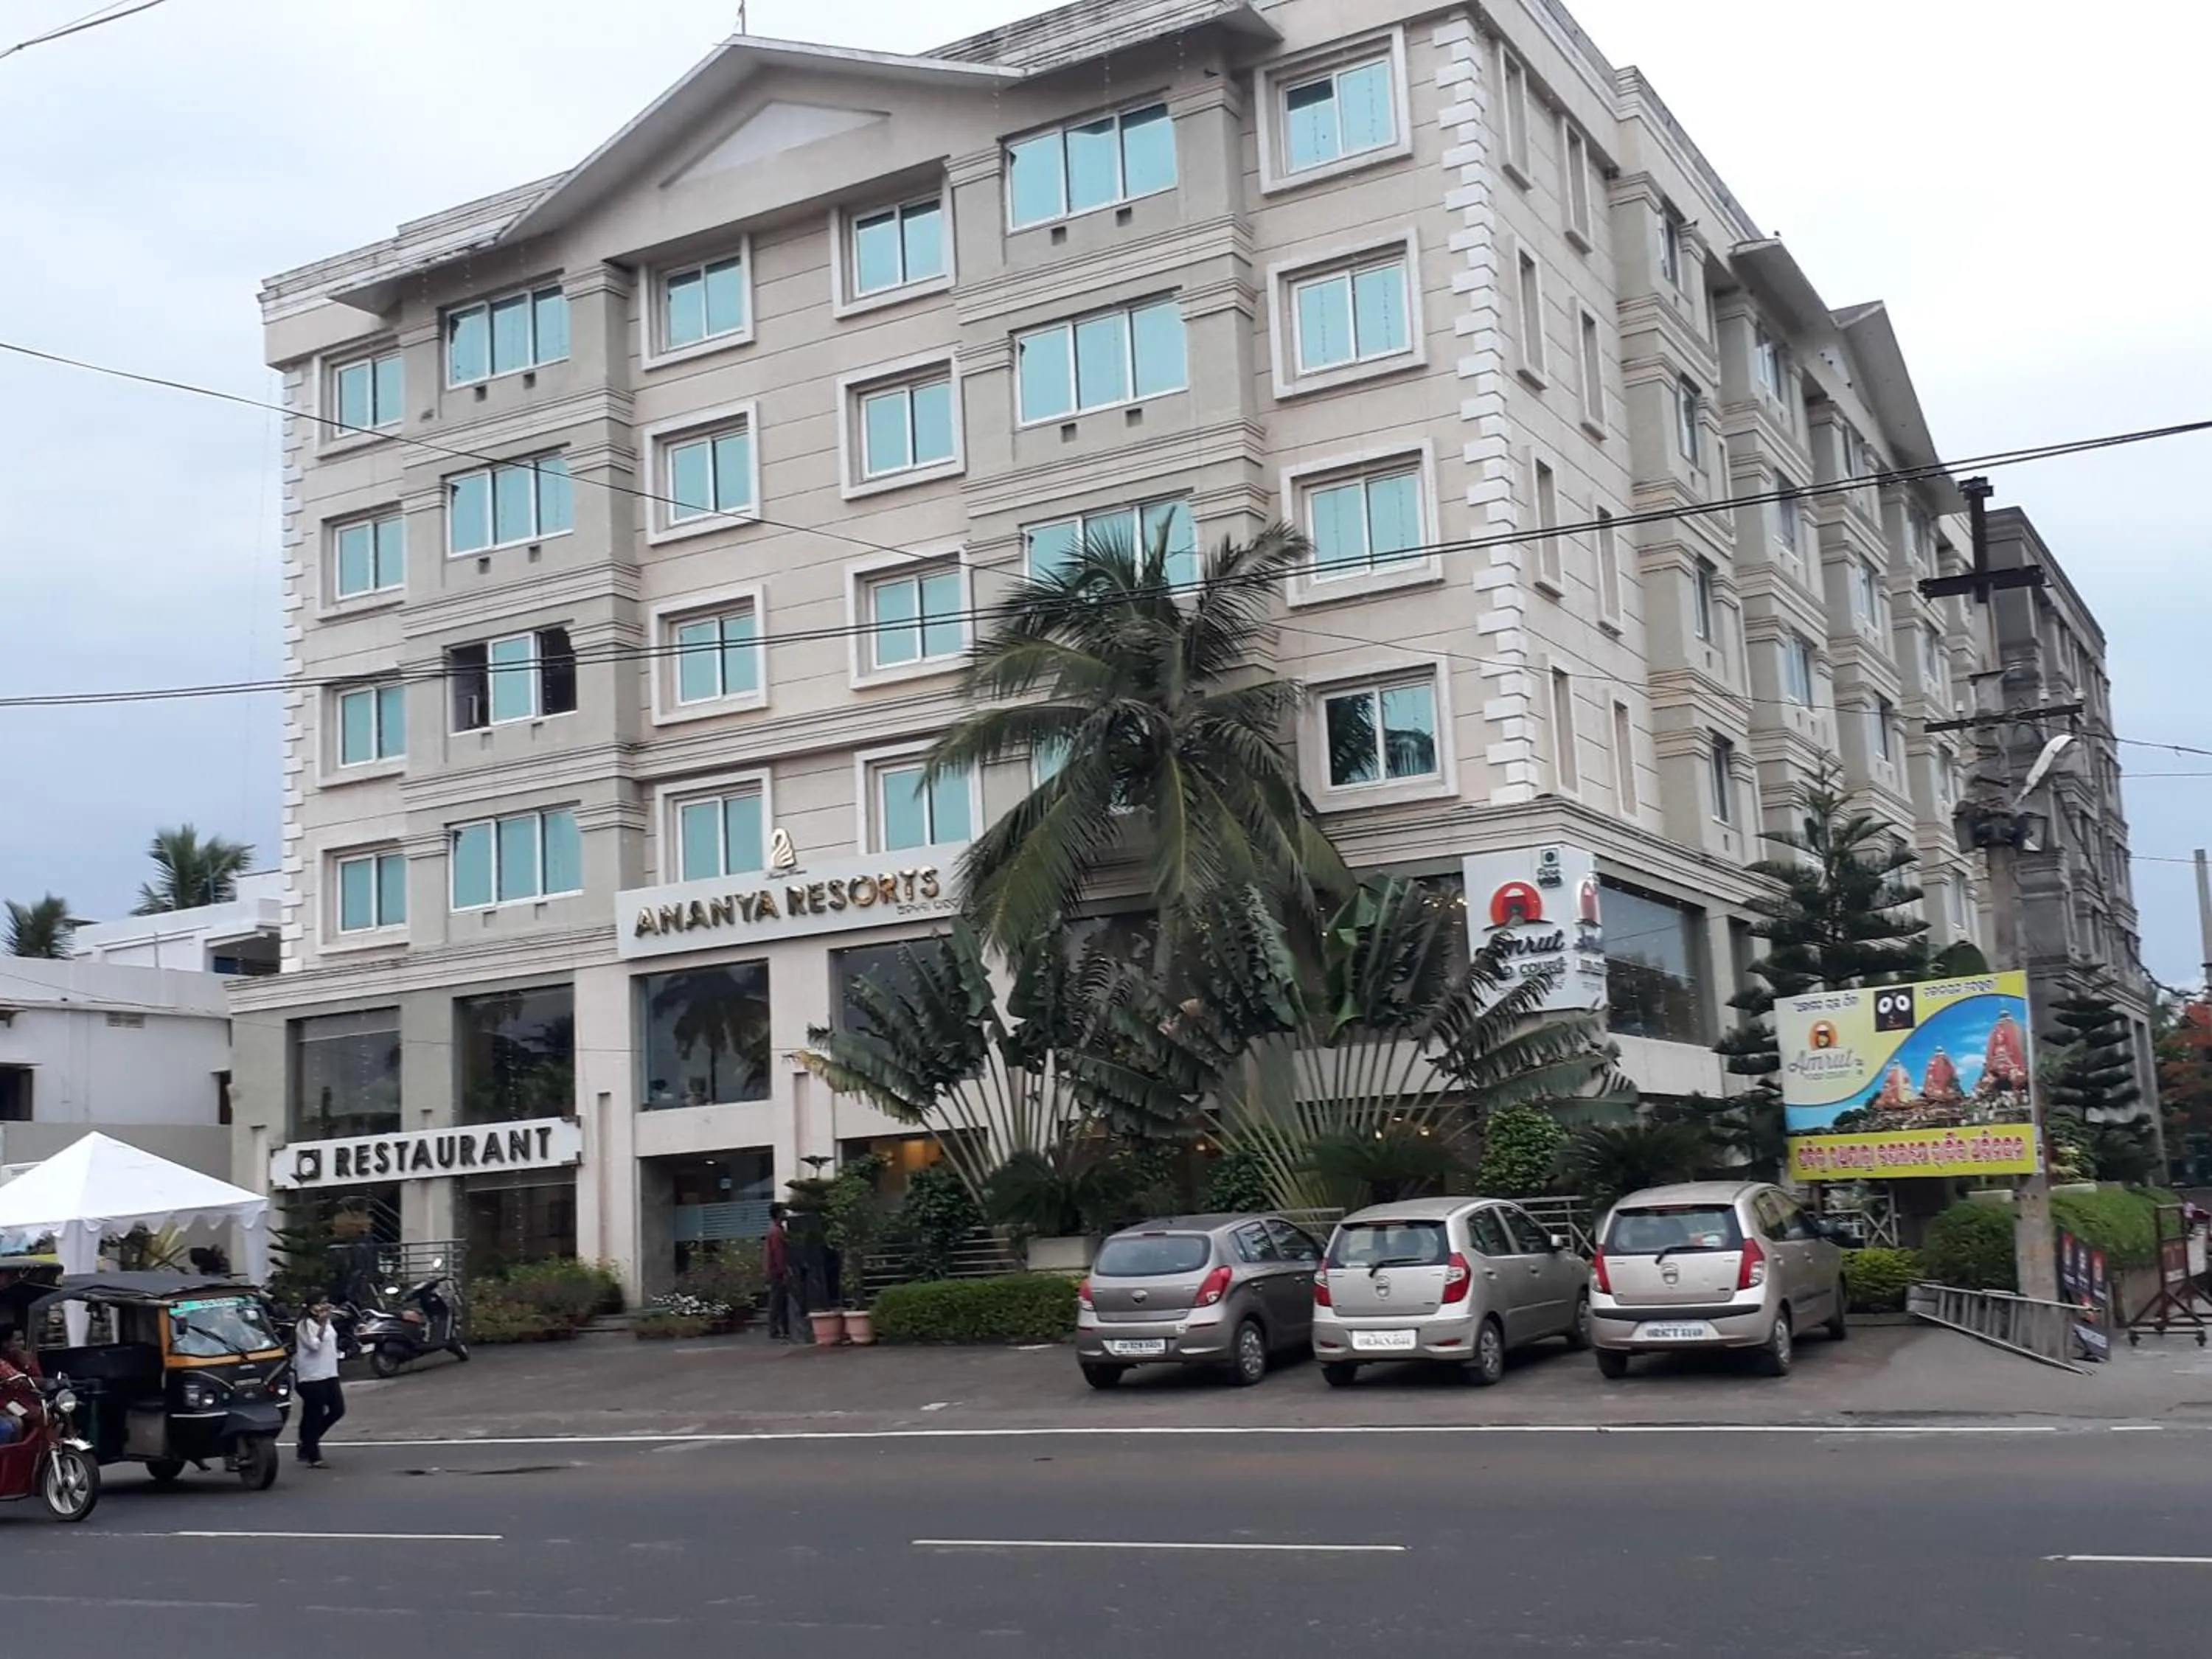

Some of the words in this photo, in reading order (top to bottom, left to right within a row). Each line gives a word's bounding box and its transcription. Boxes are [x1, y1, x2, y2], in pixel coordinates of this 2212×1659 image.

[635, 889, 780, 939] ANANYA
[786, 864, 939, 917] RESORTS
[1476, 929, 1565, 957] mrut
[335, 1127, 552, 1178] RESTAURANT
